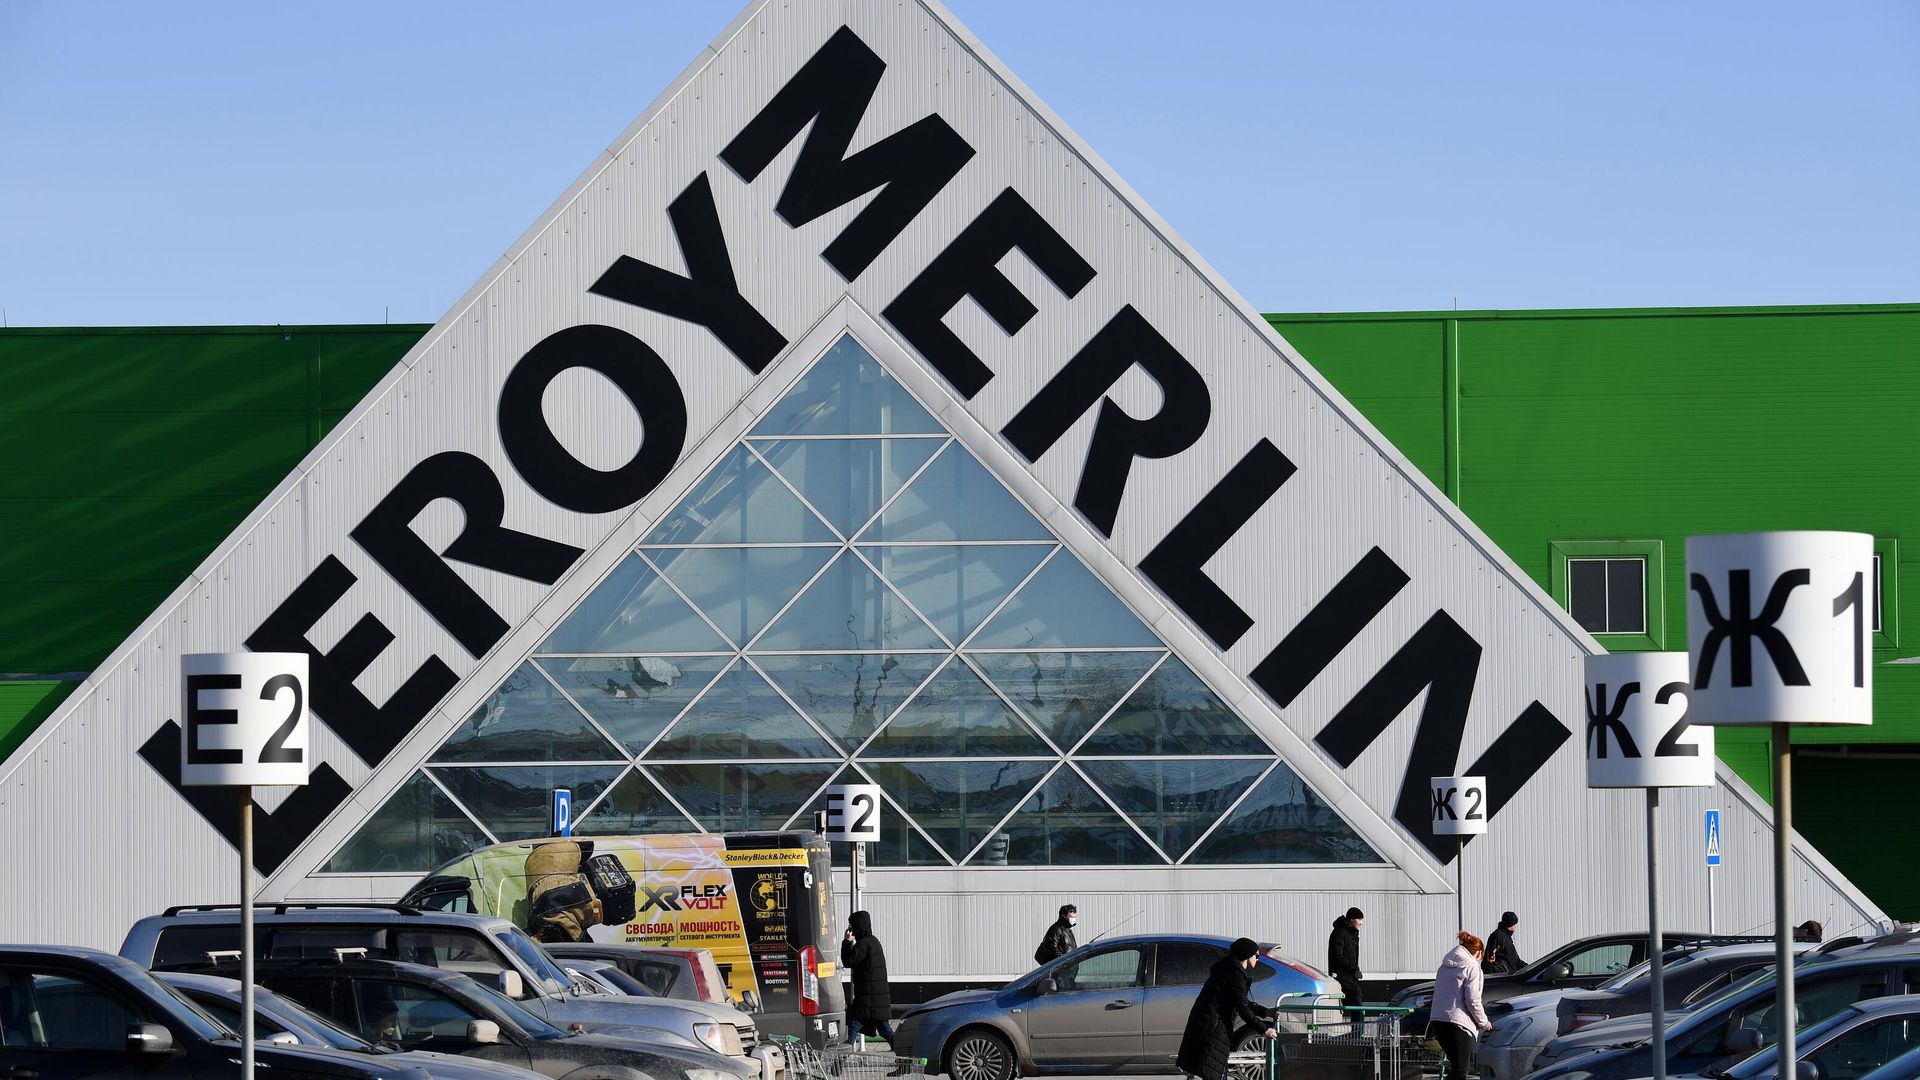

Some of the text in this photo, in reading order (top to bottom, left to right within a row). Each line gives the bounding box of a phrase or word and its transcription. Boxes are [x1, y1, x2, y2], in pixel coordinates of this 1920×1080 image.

[719, 25, 1572, 865] MERLIN
[136, 171, 790, 878] LEROY
[681, 884, 727, 897] FLEX
[638, 885, 683, 912] XR
[681, 897, 727, 910] VOLT
[625, 923, 675, 935] СВОБОДА
[680, 920, 740, 933] МОЩНОСТЬ
[705, 932, 741, 940] ИНСТРУМЕНТА
